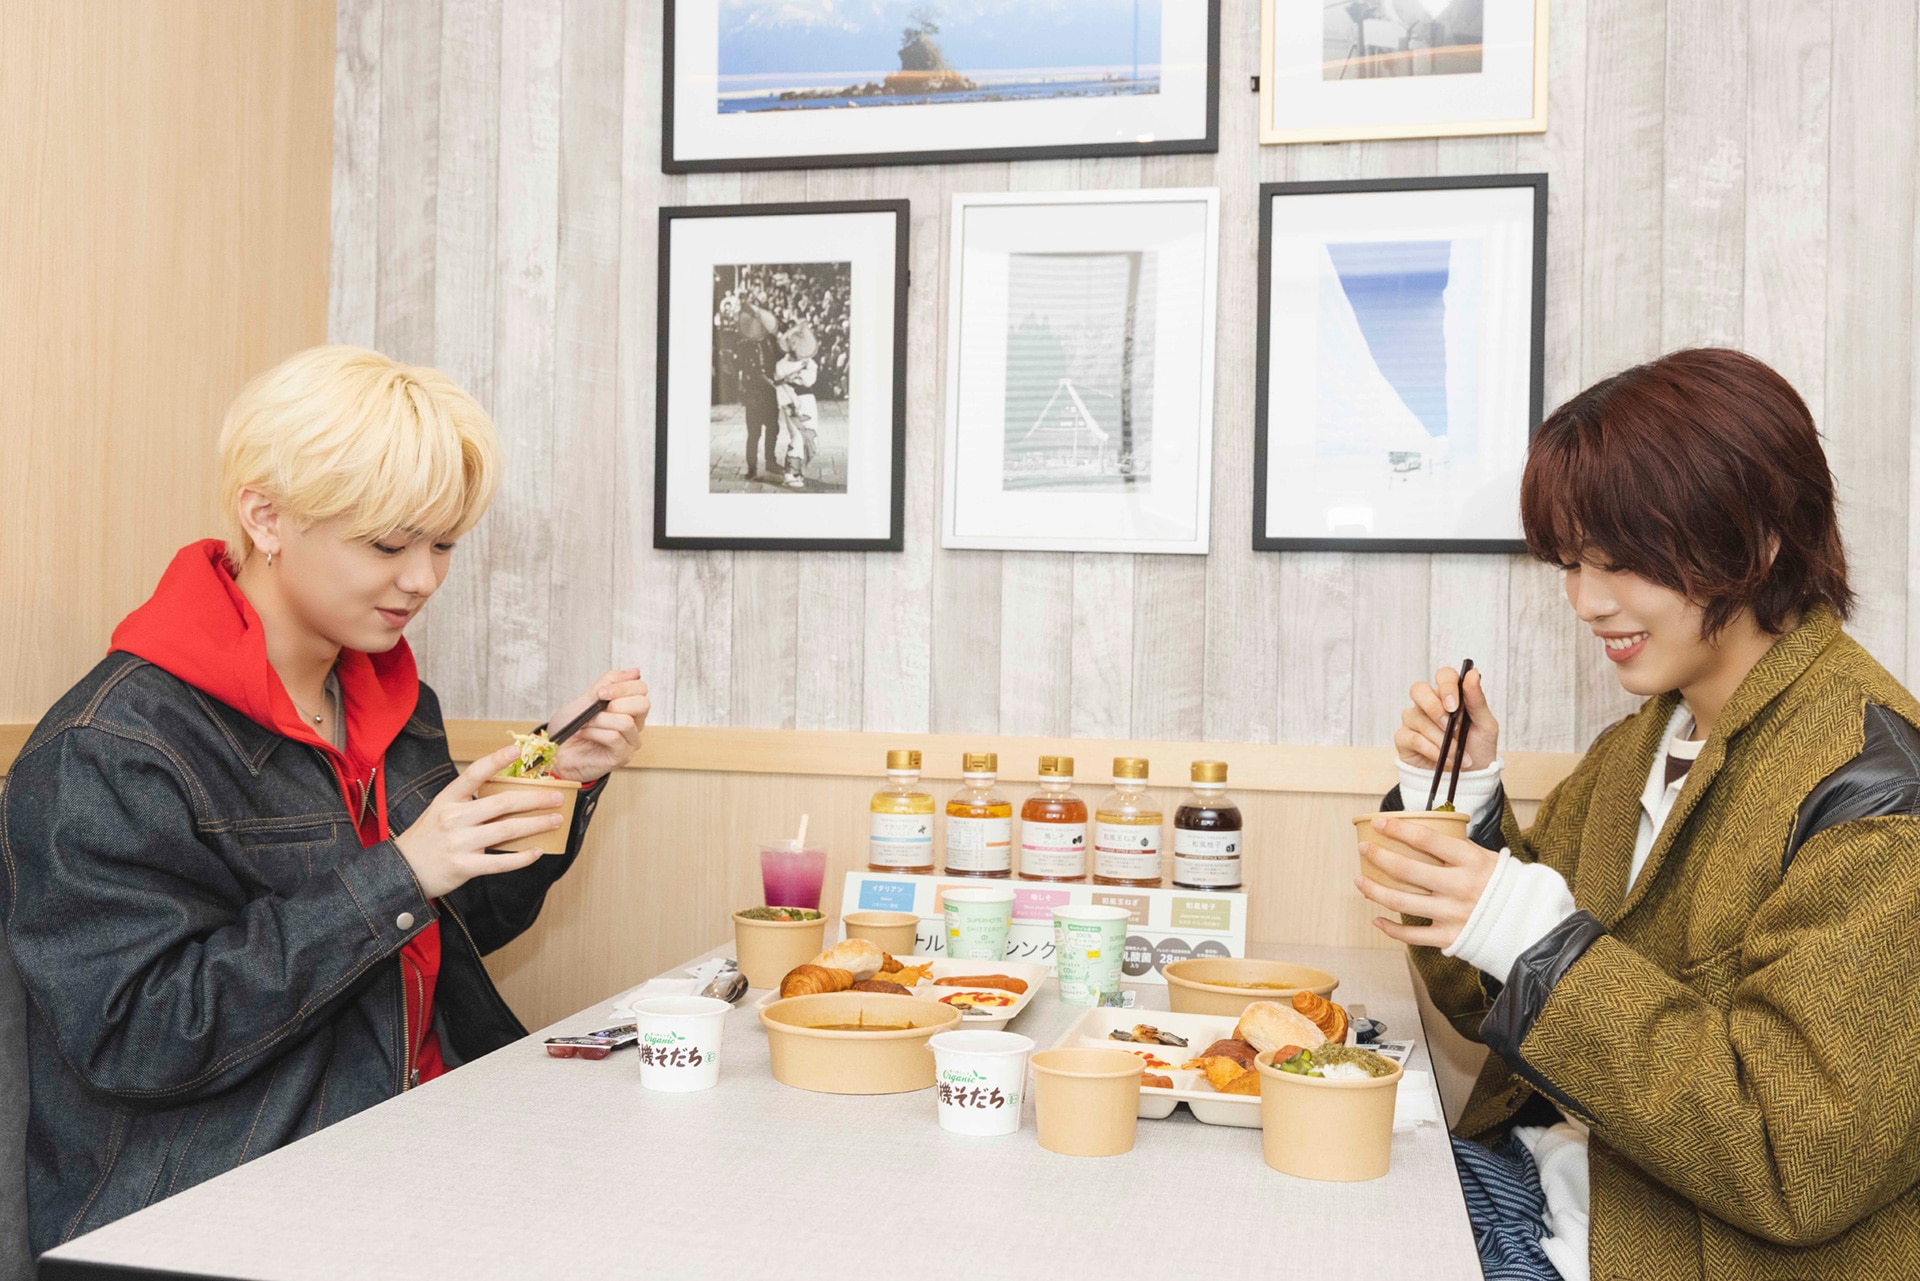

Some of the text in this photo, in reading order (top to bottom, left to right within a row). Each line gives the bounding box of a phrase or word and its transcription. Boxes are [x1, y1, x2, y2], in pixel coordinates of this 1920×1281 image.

[872, 885, 904, 893] イタリアン
[1030, 893, 1052, 902] 梅しそ
[1102, 897, 1140, 907] 和風玉ねぎ
[1186, 902, 1217, 911] 和風柚子
[644, 1033, 676, 1045] Organic
[638, 1044, 702, 1067] 機そだち
[942, 1069, 975, 1083] Organic
[937, 1079, 1004, 1109] 機そだち
